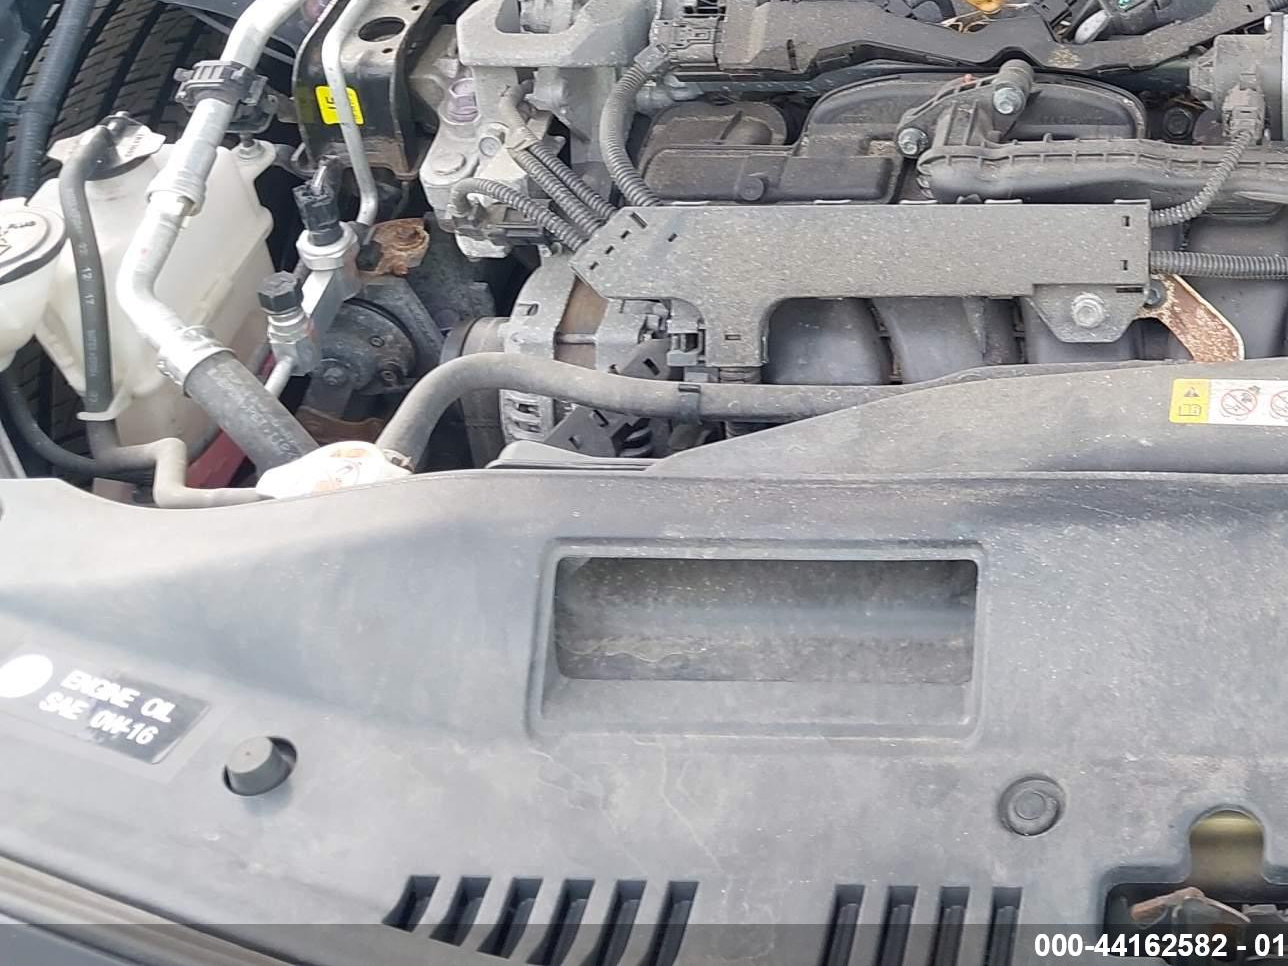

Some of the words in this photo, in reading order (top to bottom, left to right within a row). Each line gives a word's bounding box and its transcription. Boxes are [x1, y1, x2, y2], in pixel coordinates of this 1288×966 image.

[38, 691, 90, 721] SAE
[89, 709, 159, 745] 0W-16
[60, 669, 141, 708] ENGINE
[140, 697, 176, 723] OIL
